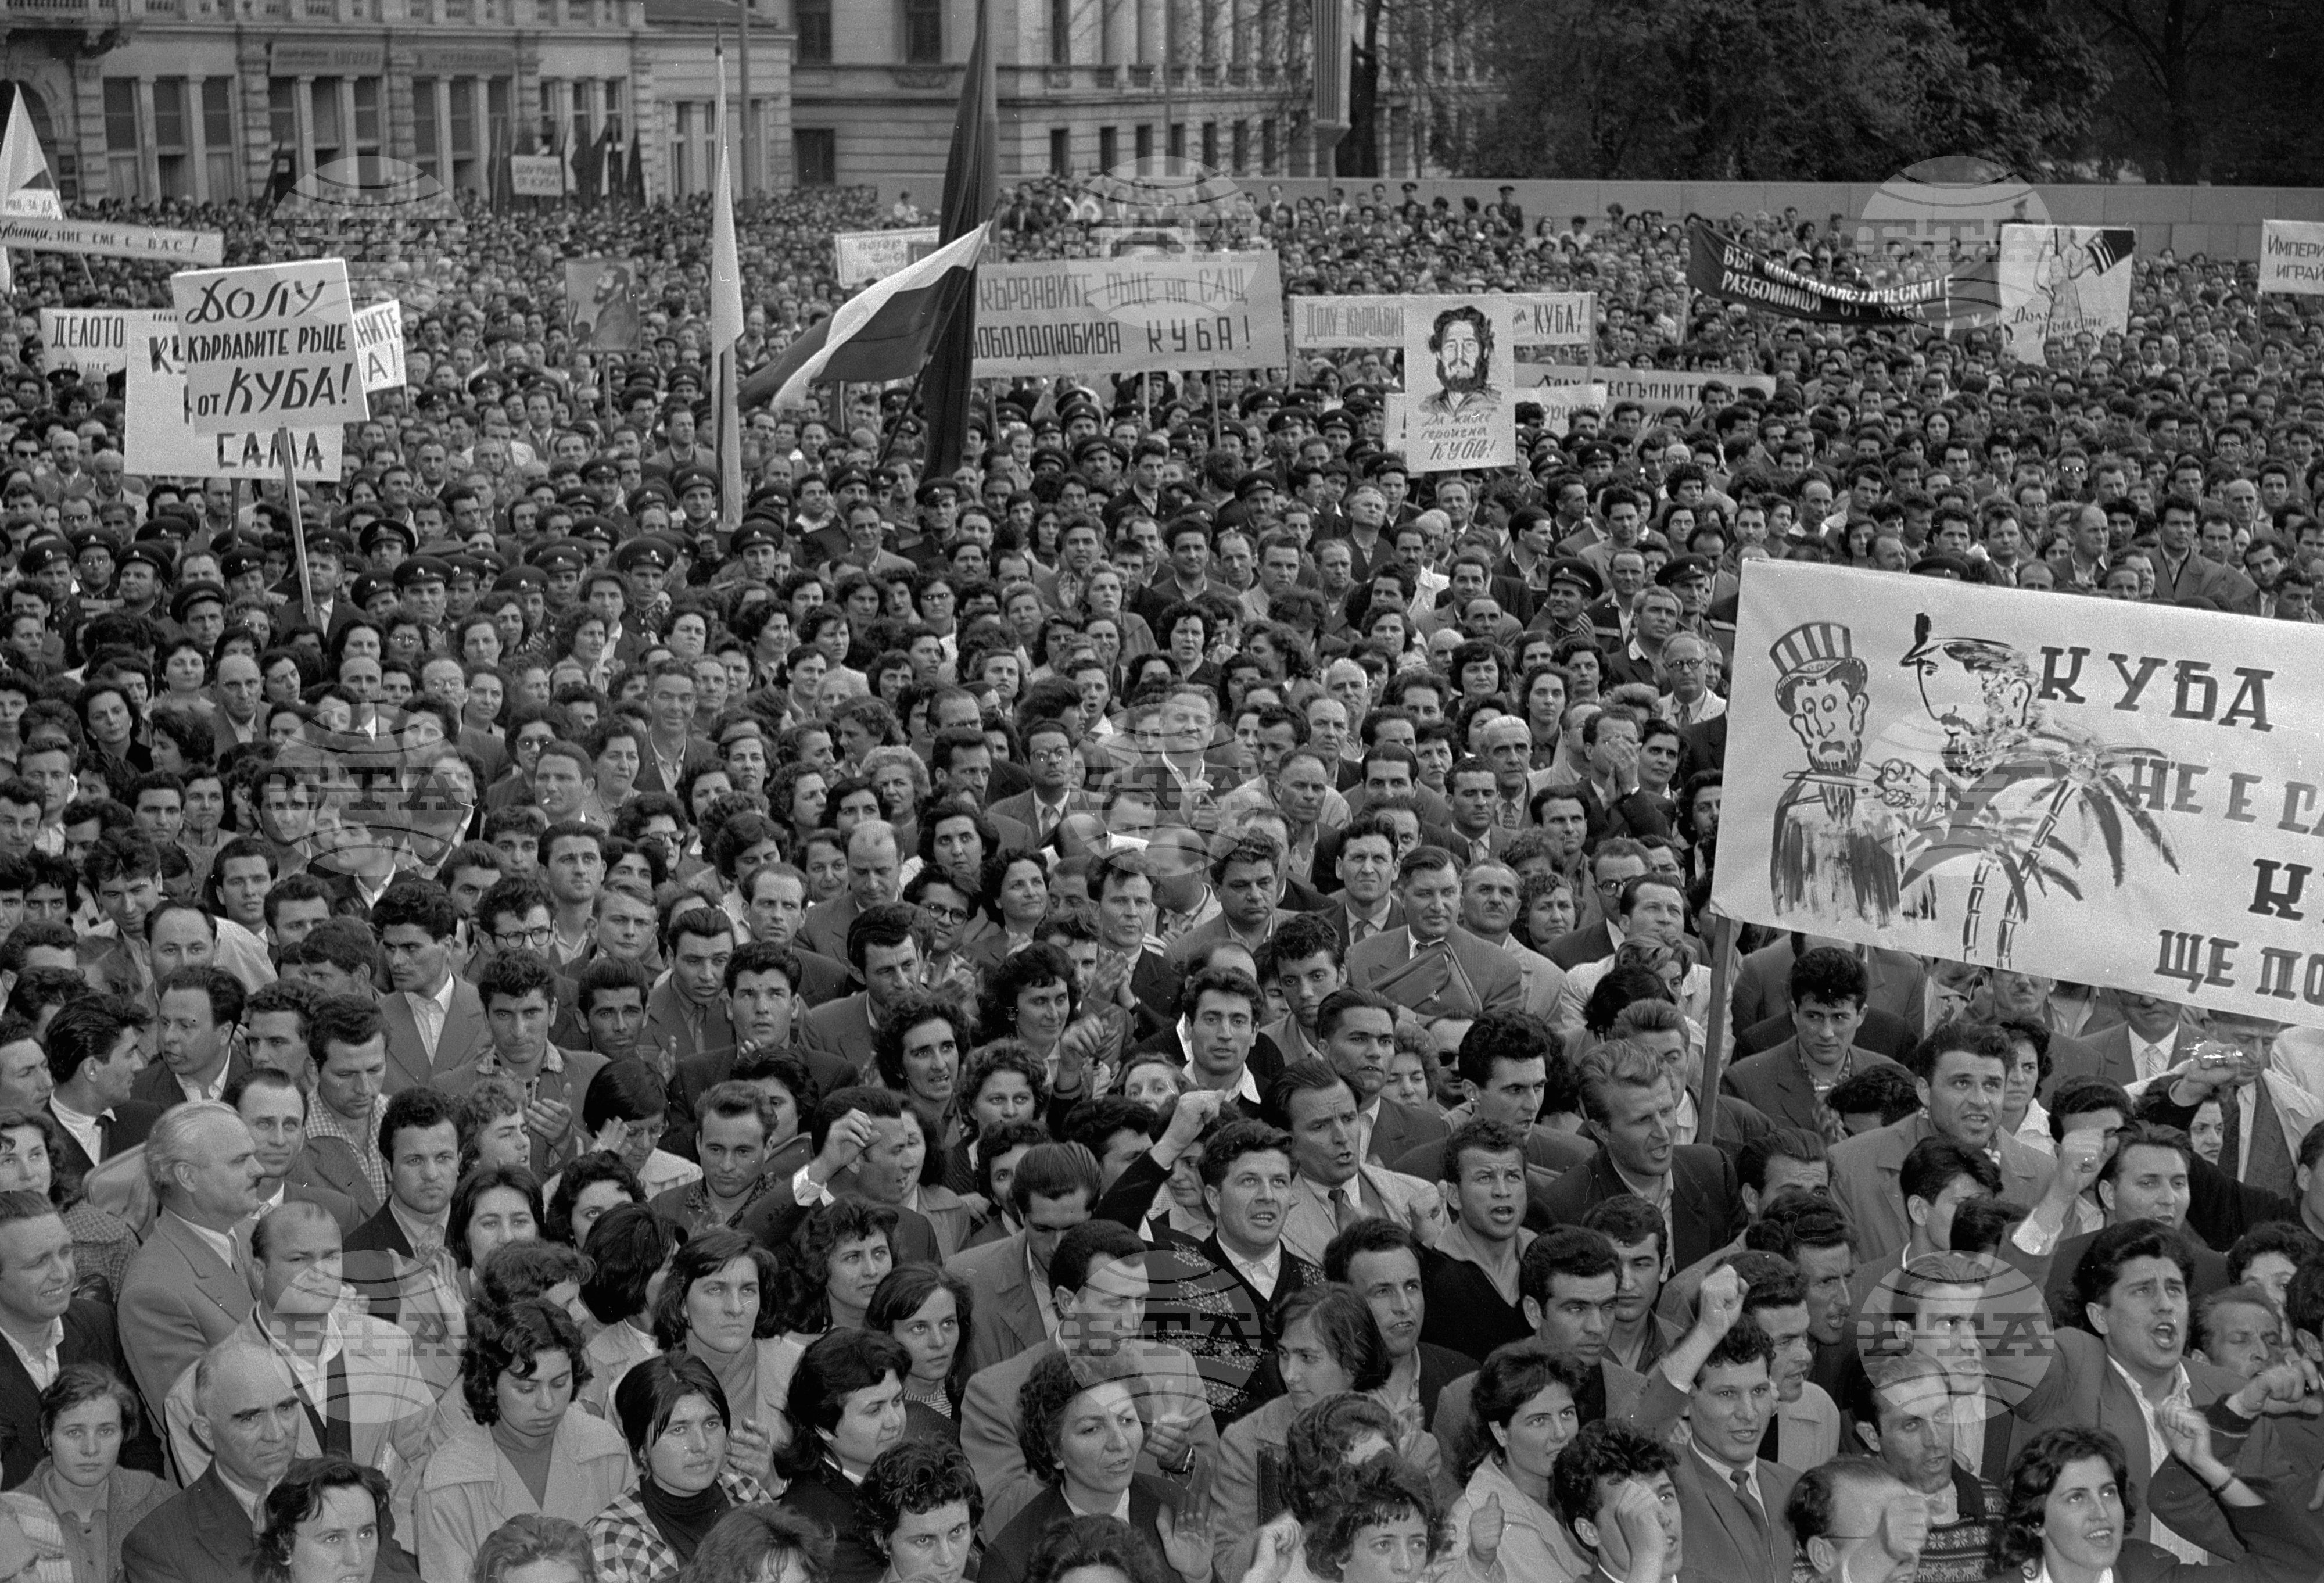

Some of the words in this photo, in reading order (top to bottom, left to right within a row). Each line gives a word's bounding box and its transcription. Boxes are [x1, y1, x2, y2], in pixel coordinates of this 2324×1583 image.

[185, 277, 326, 324] ДОЛУ
[978, 274, 1095, 311] КЪРВАВИТЕ
[1106, 271, 1157, 309] РЪЦЕ
[1199, 268, 1249, 306] САЩ
[51, 317, 124, 349] ДЕЛОТО
[354, 307, 399, 349] НИТЕ
[1146, 315, 1251, 353] КУБА!
[1534, 299, 1583, 335] КУБА!
[187, 328, 290, 363] КЪРВАВИТЕ
[297, 322, 348, 354] РЪЦЕ
[224, 362, 353, 416] КУБА!
[2037, 646, 2275, 732] КУБА
[2126, 757, 2209, 814] НЕ
[2223, 772, 2263, 823] Е
[2277, 780, 2324, 837] С
[2247, 858, 2324, 922] К
[2154, 929, 2240, 993] ЩЕ
